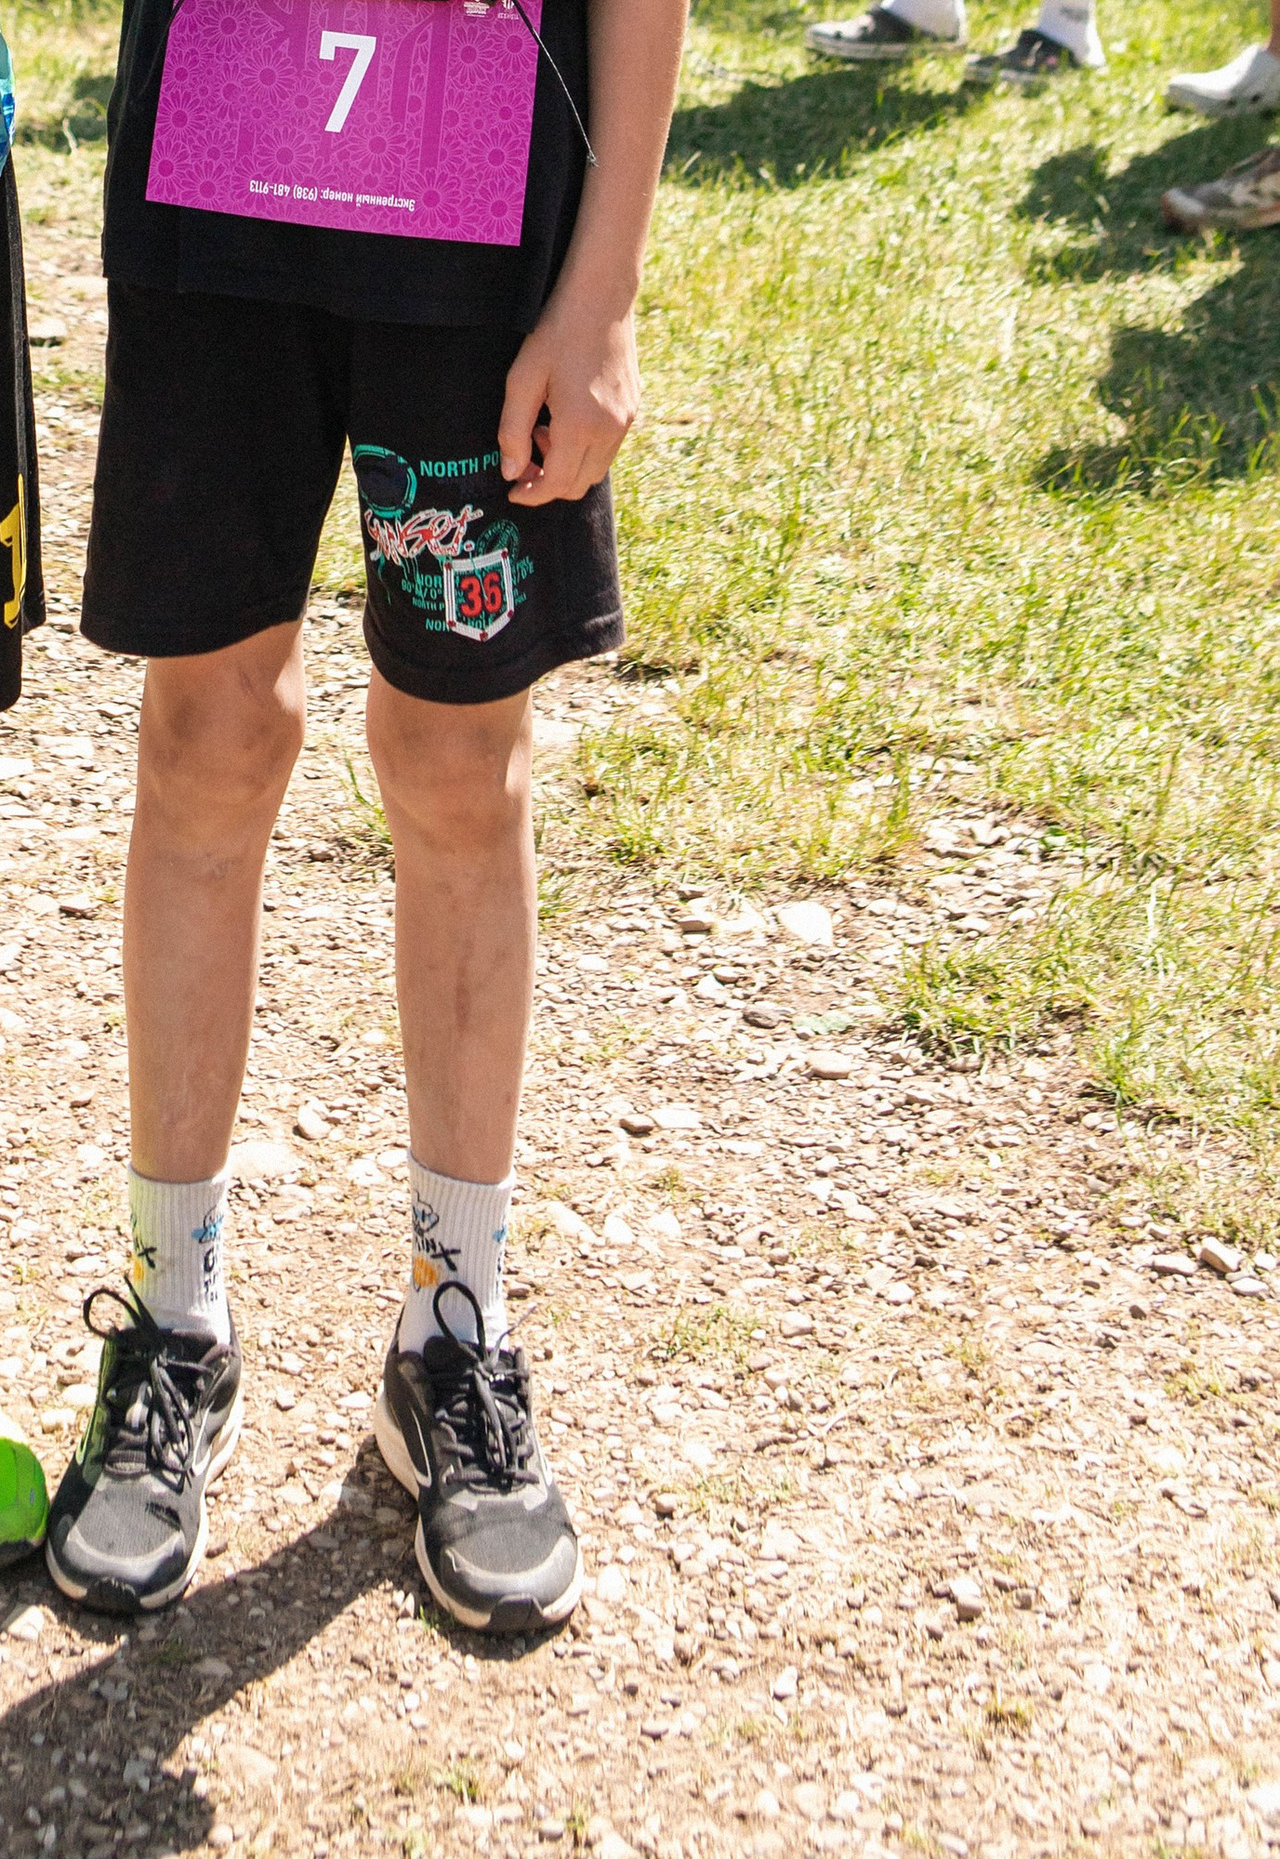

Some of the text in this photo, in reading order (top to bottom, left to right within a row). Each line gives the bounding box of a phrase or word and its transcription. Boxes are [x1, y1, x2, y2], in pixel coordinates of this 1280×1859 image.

[319, 30, 377, 133] 7
[249, 179, 415, 212] Экстренный номер: (938) 481-9113
[420, 457, 478, 478] NORTH
[460, 571, 502, 618] 36
